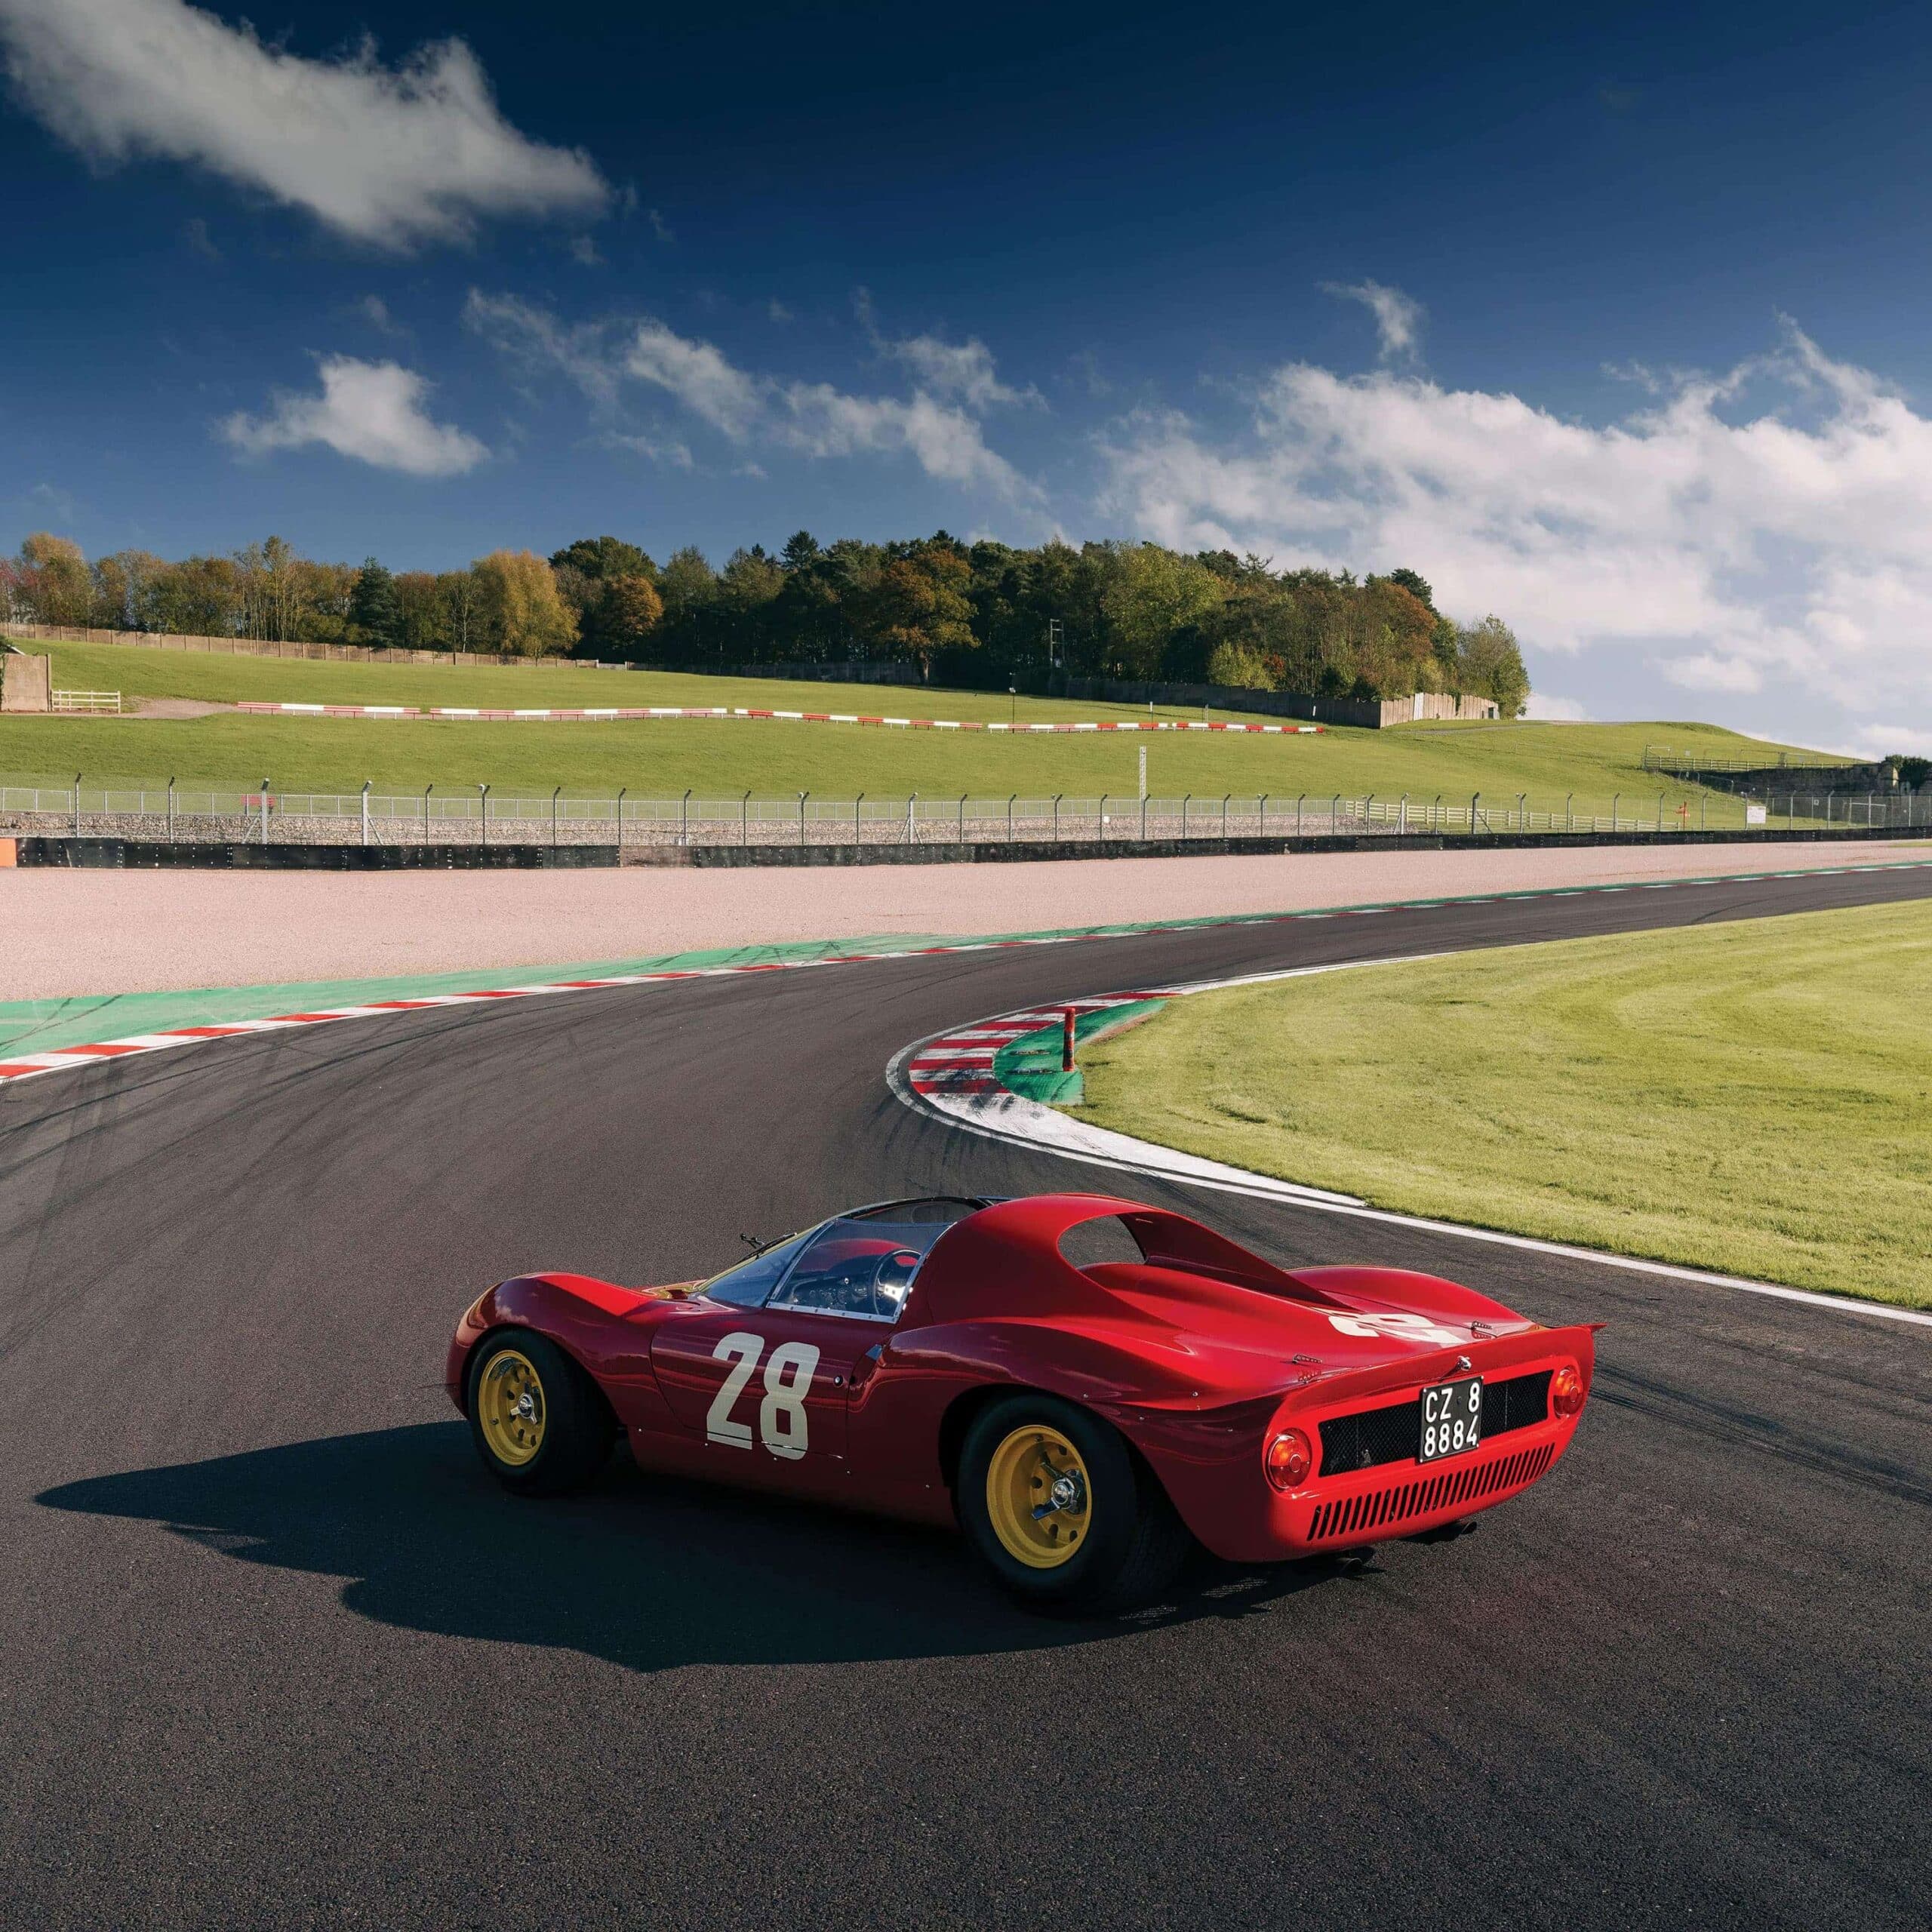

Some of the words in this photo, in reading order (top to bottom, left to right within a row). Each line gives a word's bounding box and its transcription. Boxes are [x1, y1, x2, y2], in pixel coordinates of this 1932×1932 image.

[706, 1332, 820, 1460] 28
[1426, 1387, 1453, 1423] CZ
[1468, 1382, 1480, 1413] 8
[1424, 1415, 1478, 1457] 8884
